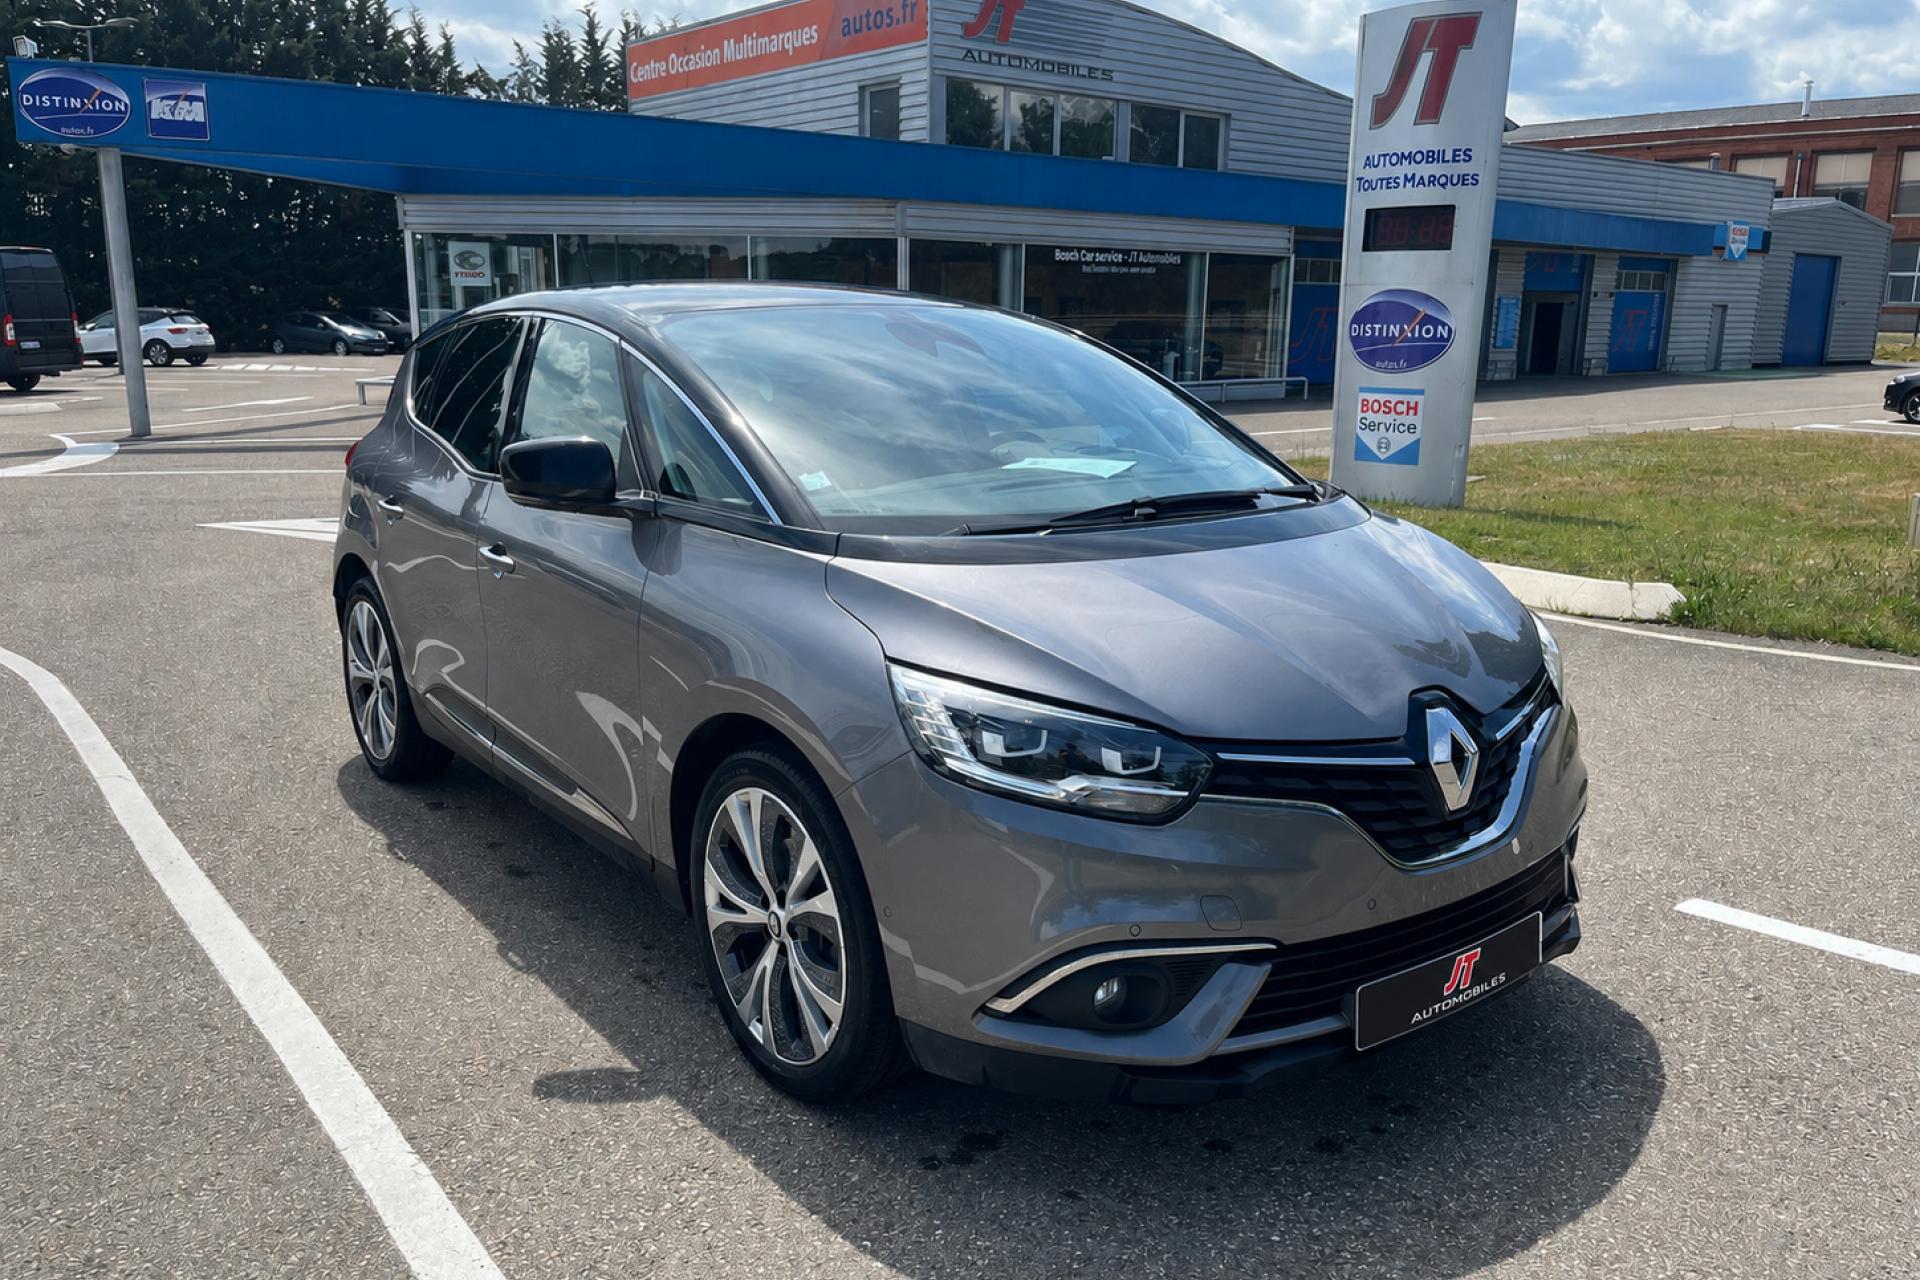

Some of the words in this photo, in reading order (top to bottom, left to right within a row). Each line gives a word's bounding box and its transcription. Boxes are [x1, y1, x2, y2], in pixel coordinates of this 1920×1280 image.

[841, 0, 918, 38] autos.fr
[630, 60, 668, 83] Centre
[668, 46, 721, 74] Occasion
[723, 23, 819, 64] Multimarques
[961, 49, 1115, 82] AUTOMOBILES
[21, 94, 127, 112] DISTINXION
[1363, 148, 1473, 169] AUTOMOBILES
[1356, 176, 1401, 193] TOUTES
[1402, 172, 1480, 190] MARQUES
[1054, 248, 1079, 261] Bosch
[1351, 323, 1449, 339] DISTINXION
[1360, 398, 1420, 417] BOSCH
[1359, 416, 1418, 434] Service
[1443, 947, 1482, 996] JT
[1411, 971, 1507, 1025] AUTOMOBILES
